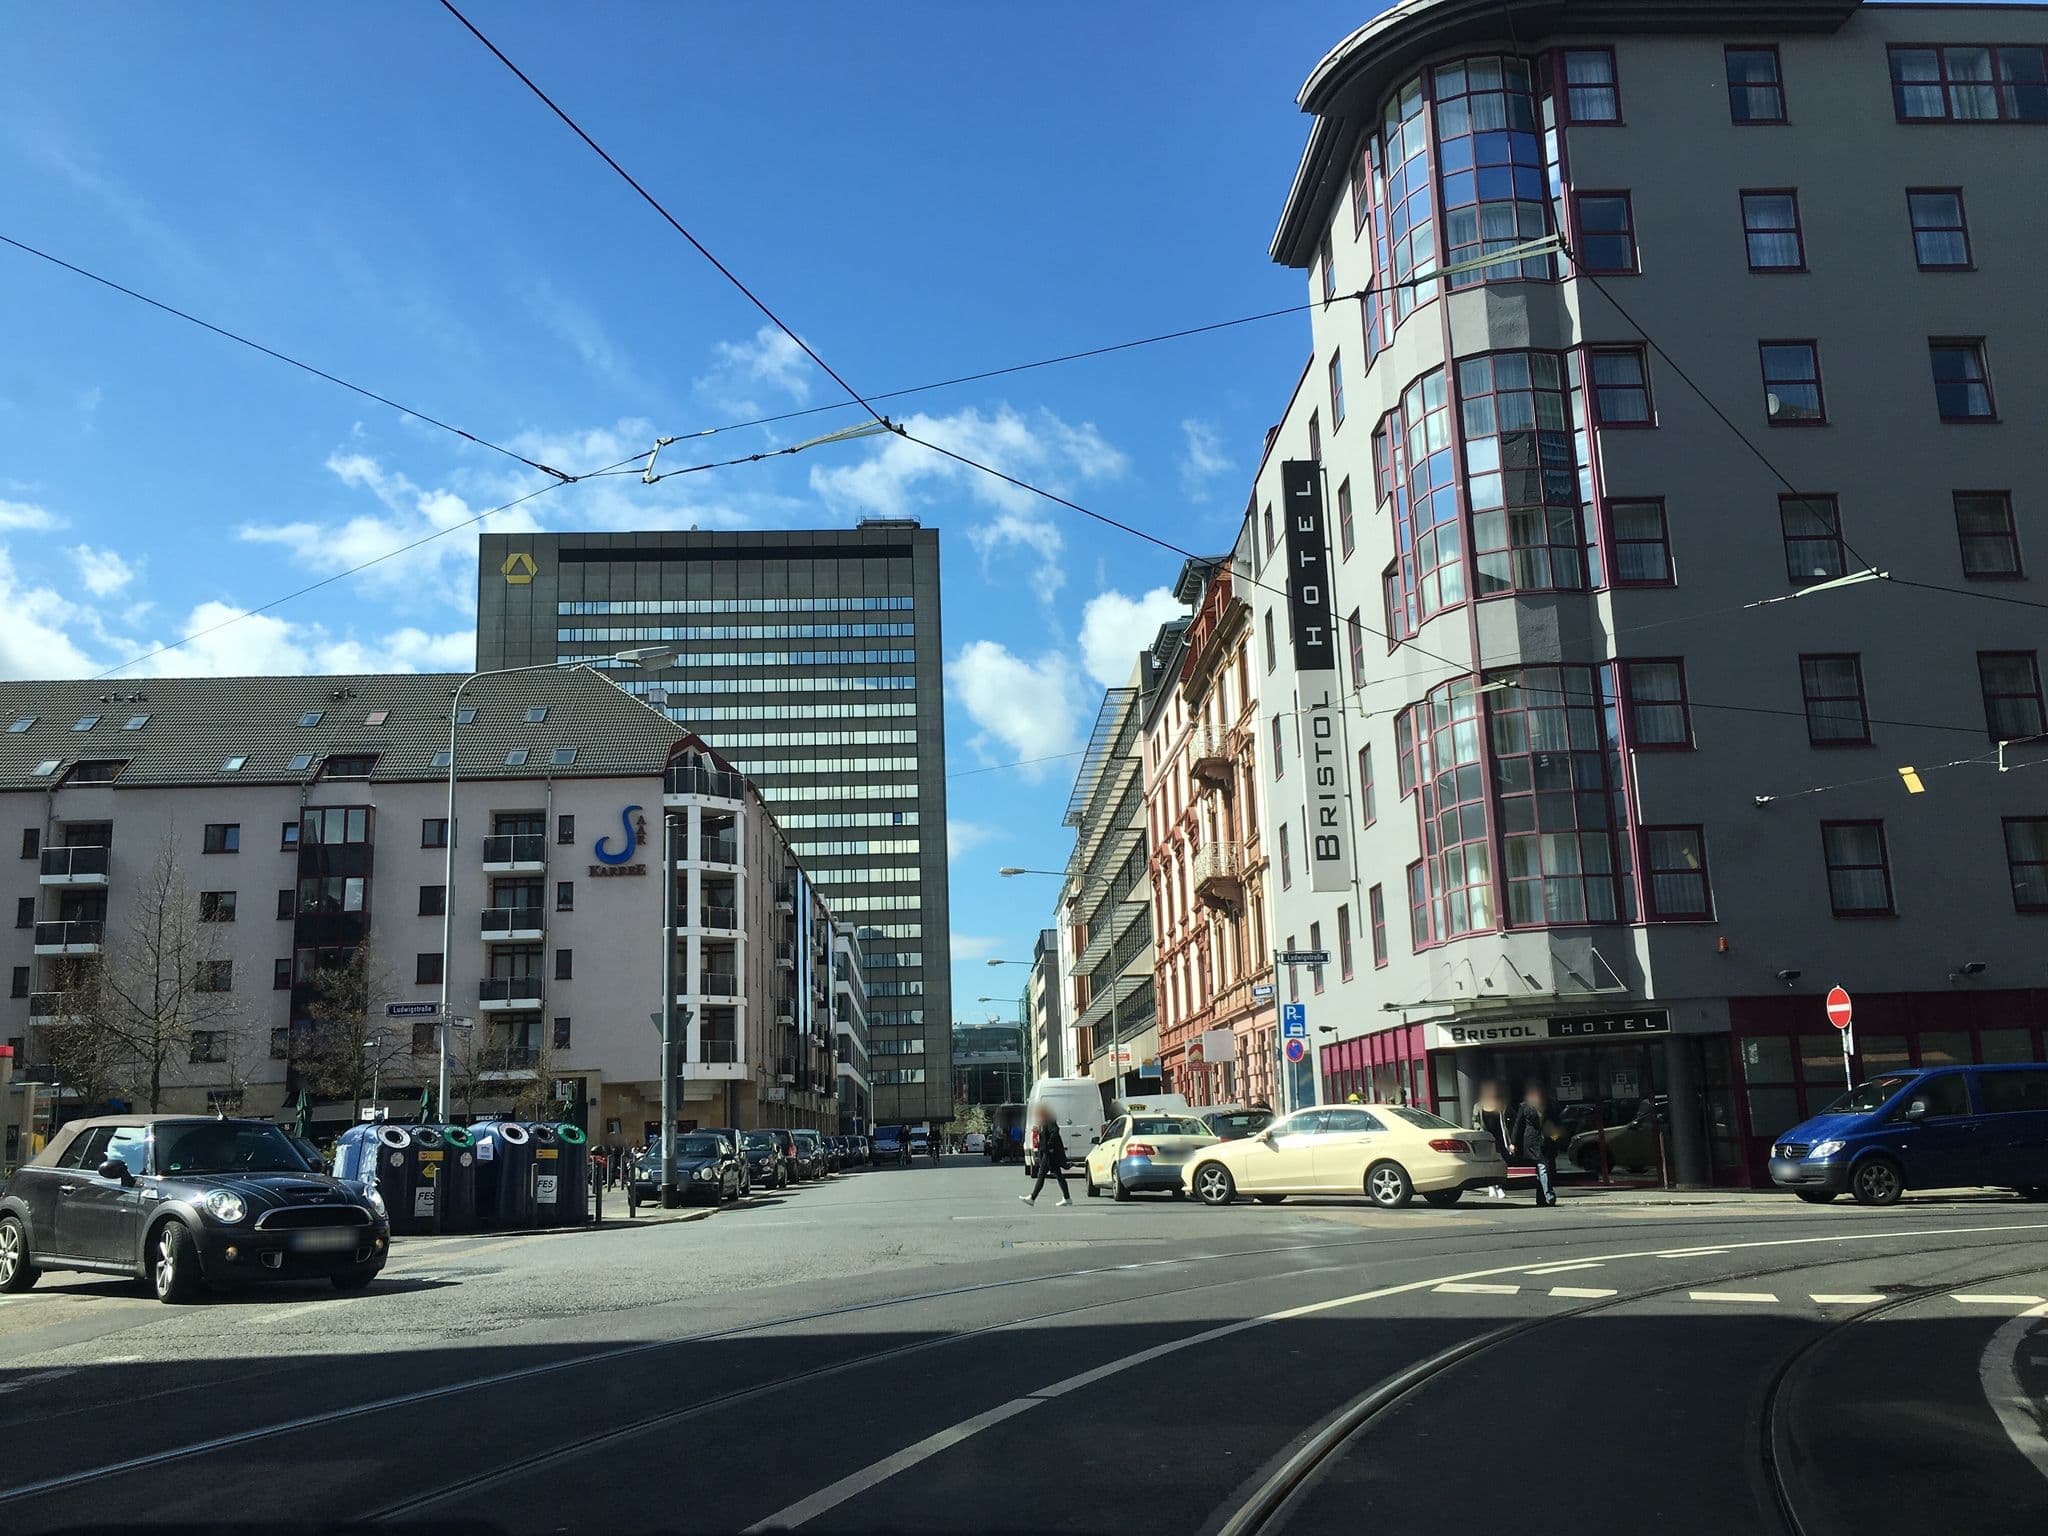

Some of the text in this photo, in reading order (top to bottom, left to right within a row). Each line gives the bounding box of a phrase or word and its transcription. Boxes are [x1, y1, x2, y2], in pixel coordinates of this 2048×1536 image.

[1296, 480, 1341, 861] BRISTOL HOTEL
[588, 864, 647, 877] KARREE
[1451, 1018, 1656, 1041] BRISTOL HOTEL
[538, 1180, 554, 1189] FES
[418, 1191, 436, 1201] FES
